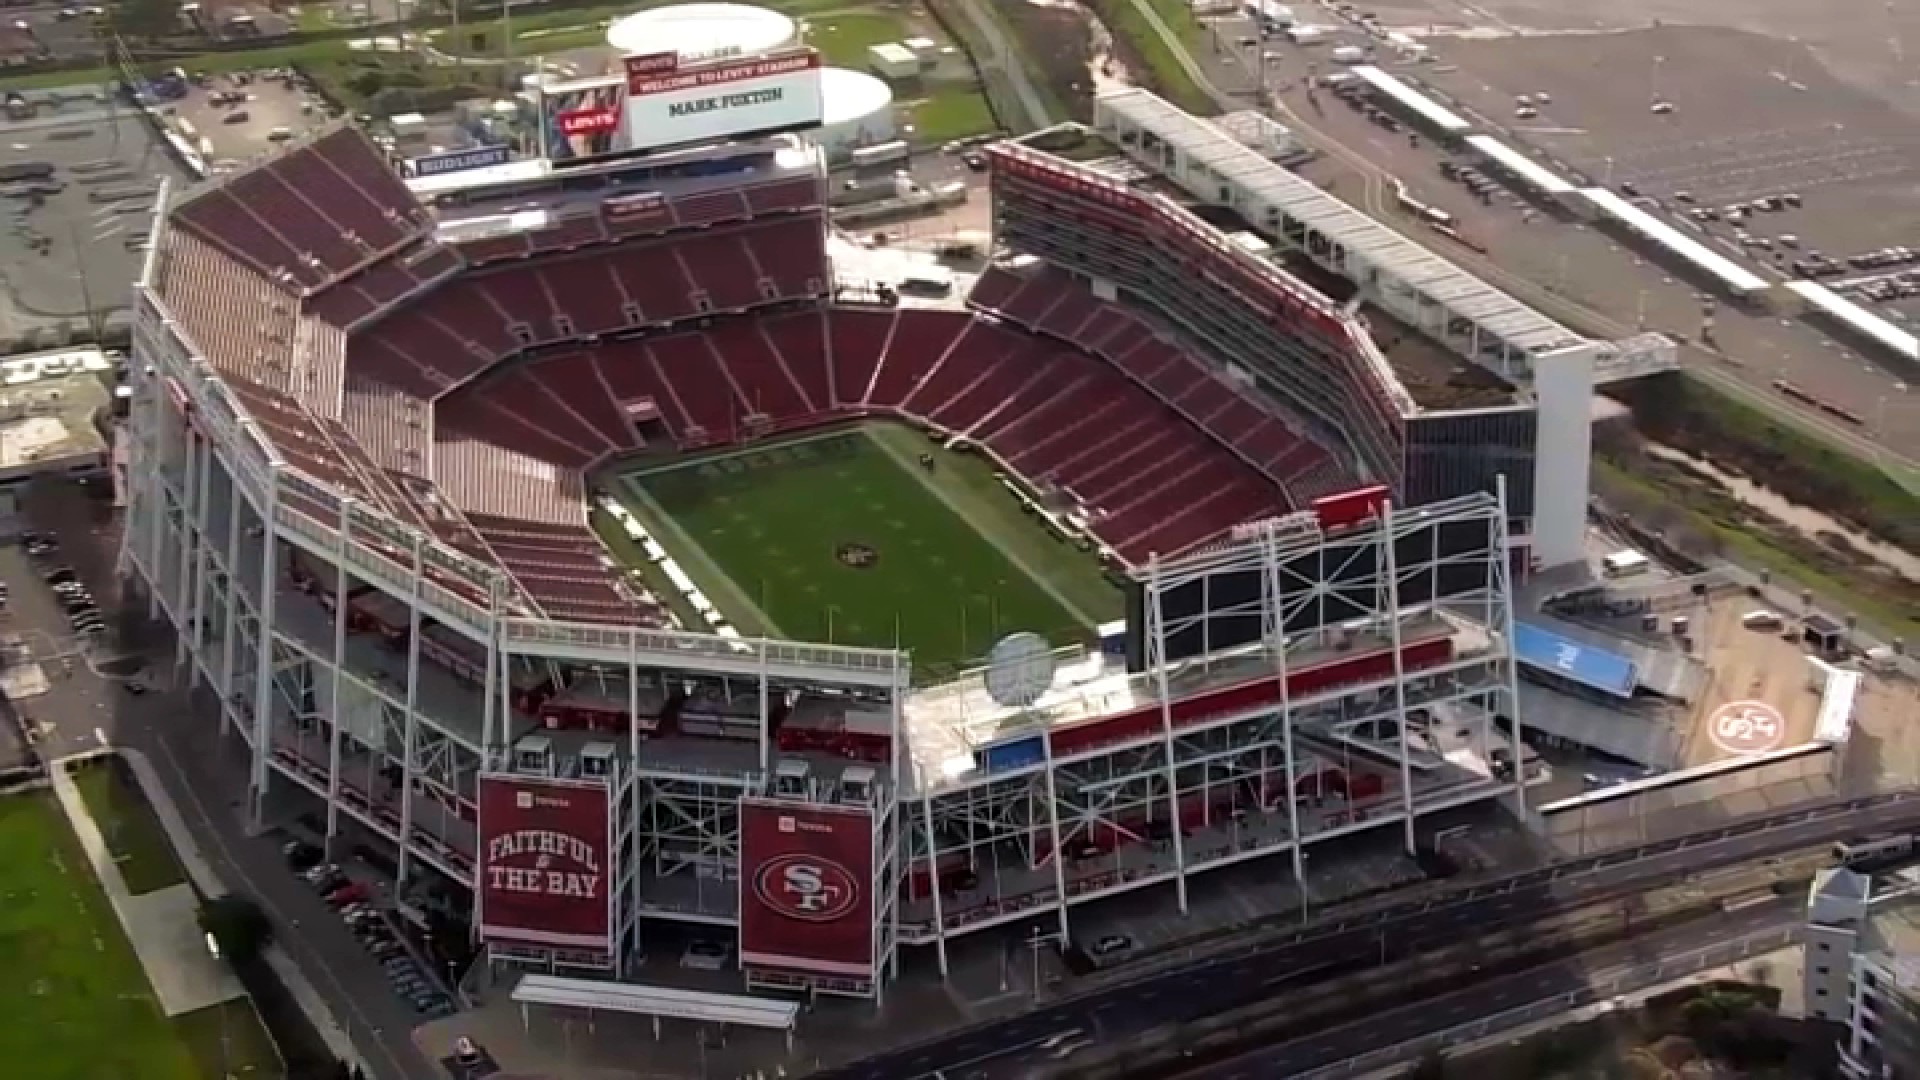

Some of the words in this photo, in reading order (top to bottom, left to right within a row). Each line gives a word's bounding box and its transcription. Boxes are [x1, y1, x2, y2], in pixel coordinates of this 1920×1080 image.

[639, 75, 697, 92] WELCOME
[699, 72, 715, 84] TO
[756, 57, 809, 75] STADIUM
[668, 97, 718, 117] MARK
[488, 829, 599, 874] FAITHFUL
[487, 865, 542, 893] THE
[546, 871, 599, 899] BAY
[783, 863, 841, 911] SF
